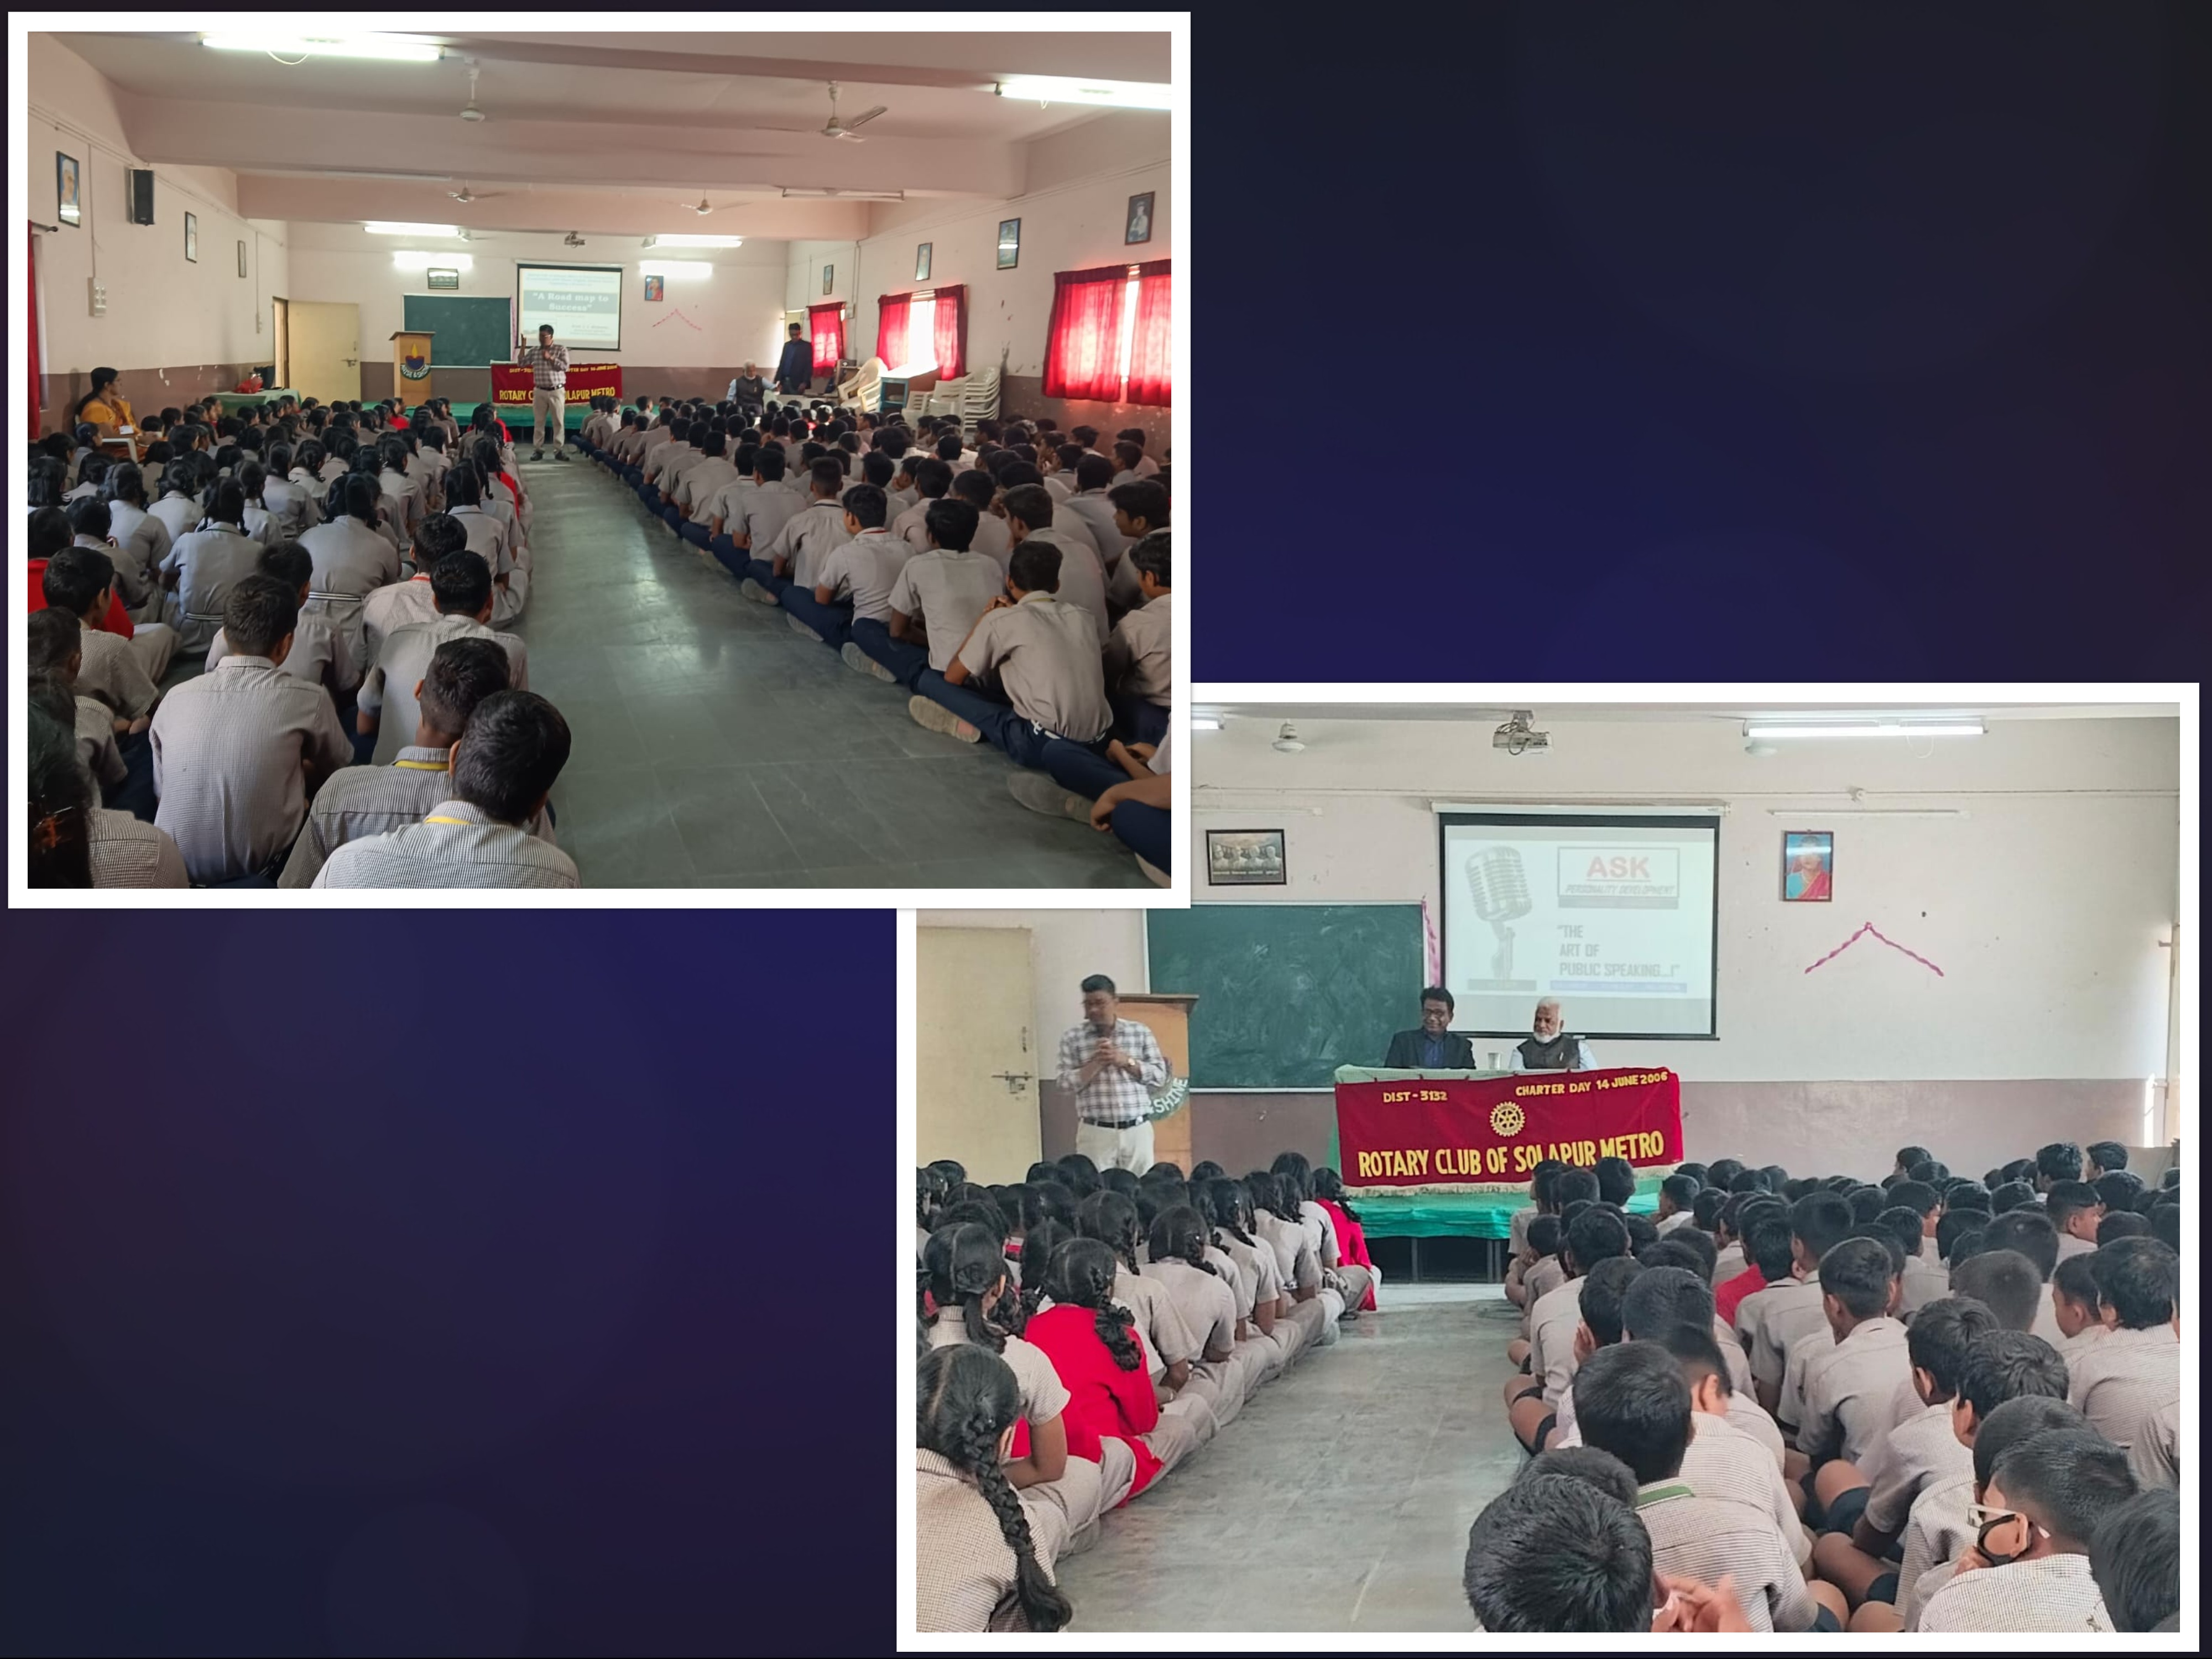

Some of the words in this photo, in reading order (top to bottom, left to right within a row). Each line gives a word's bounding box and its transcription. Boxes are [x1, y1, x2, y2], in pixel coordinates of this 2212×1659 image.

[547, 293, 572, 302] Road
[575, 295, 596, 303] map
[499, 390, 526, 400] ROTARY
[1587, 856, 1650, 878] ASK
[1559, 943, 1581, 957] ART
[1585, 944, 1600, 957] OF
[1559, 962, 1601, 976] PUBLIC
[1515, 1083, 1565, 1097] CHARTER
[1569, 1082, 1591, 1093] DAY
[1596, 1079, 1610, 1090] 14
[1611, 1074, 1639, 1088] JUNE
[1640, 1071, 1668, 1084] 2006
[1154, 1078, 1188, 1113] SHINE
[1358, 1149, 1430, 1177] ROTARY
[1435, 1148, 1482, 1176] CLUB
[1486, 1146, 1508, 1174] OF
[1599, 1130, 1664, 1161] METRO
